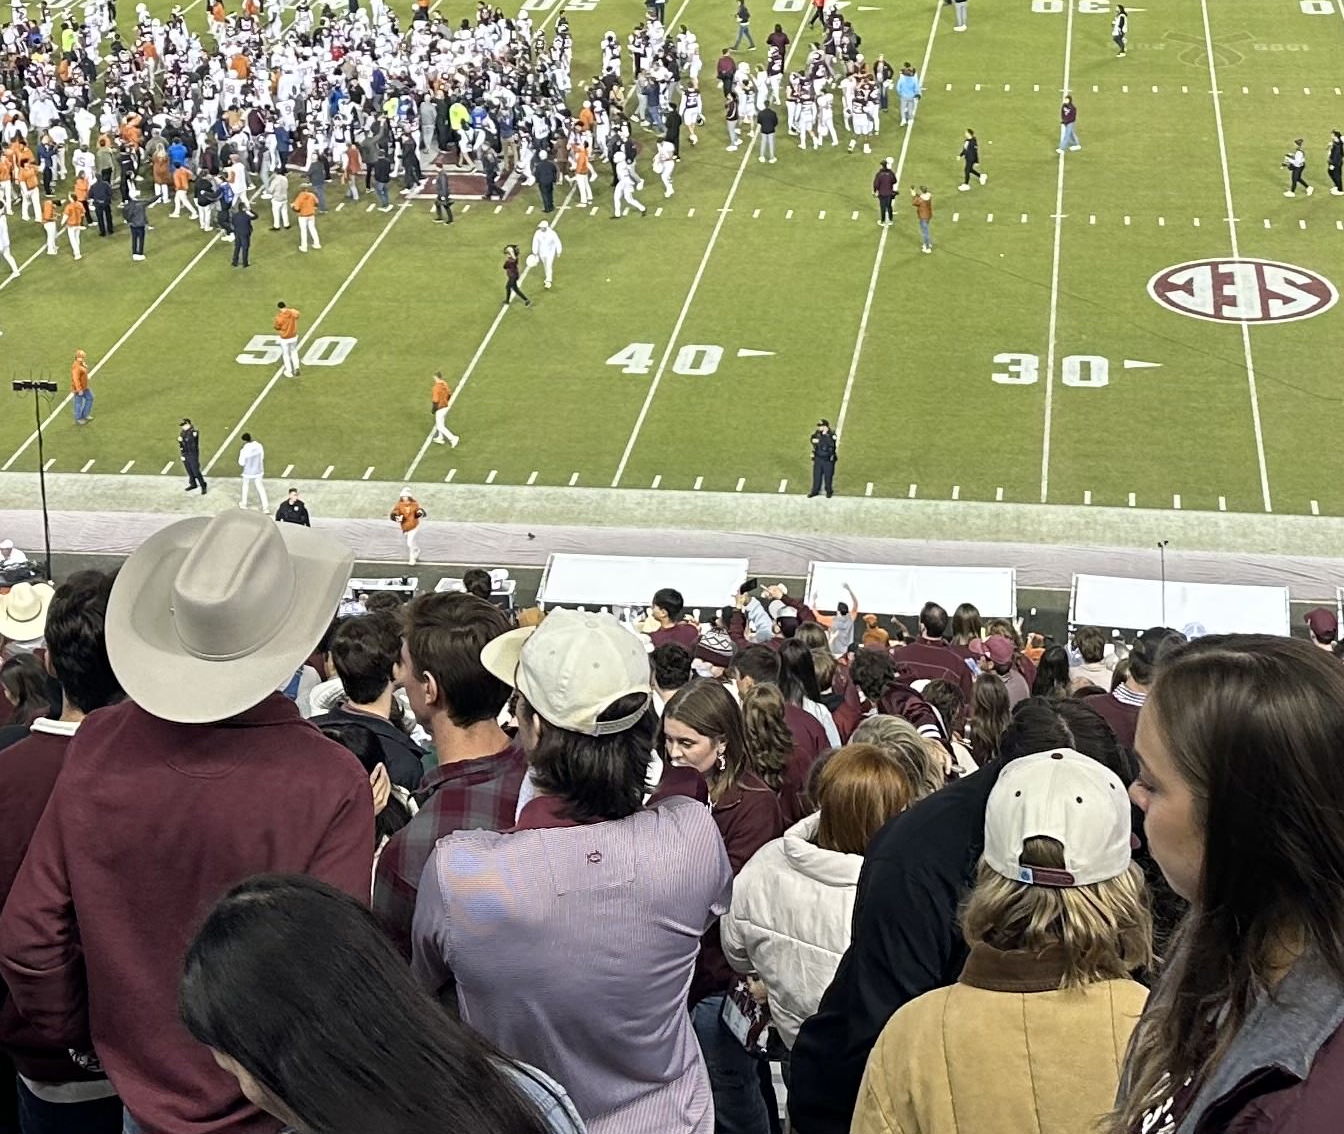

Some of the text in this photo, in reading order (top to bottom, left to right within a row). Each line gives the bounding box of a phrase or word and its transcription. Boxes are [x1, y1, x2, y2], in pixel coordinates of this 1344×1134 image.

[1164, 262, 1322, 319] SEC
[236, 335, 358, 366] 50
[605, 342, 724, 375] 40
[991, 352, 1109, 388] 30
